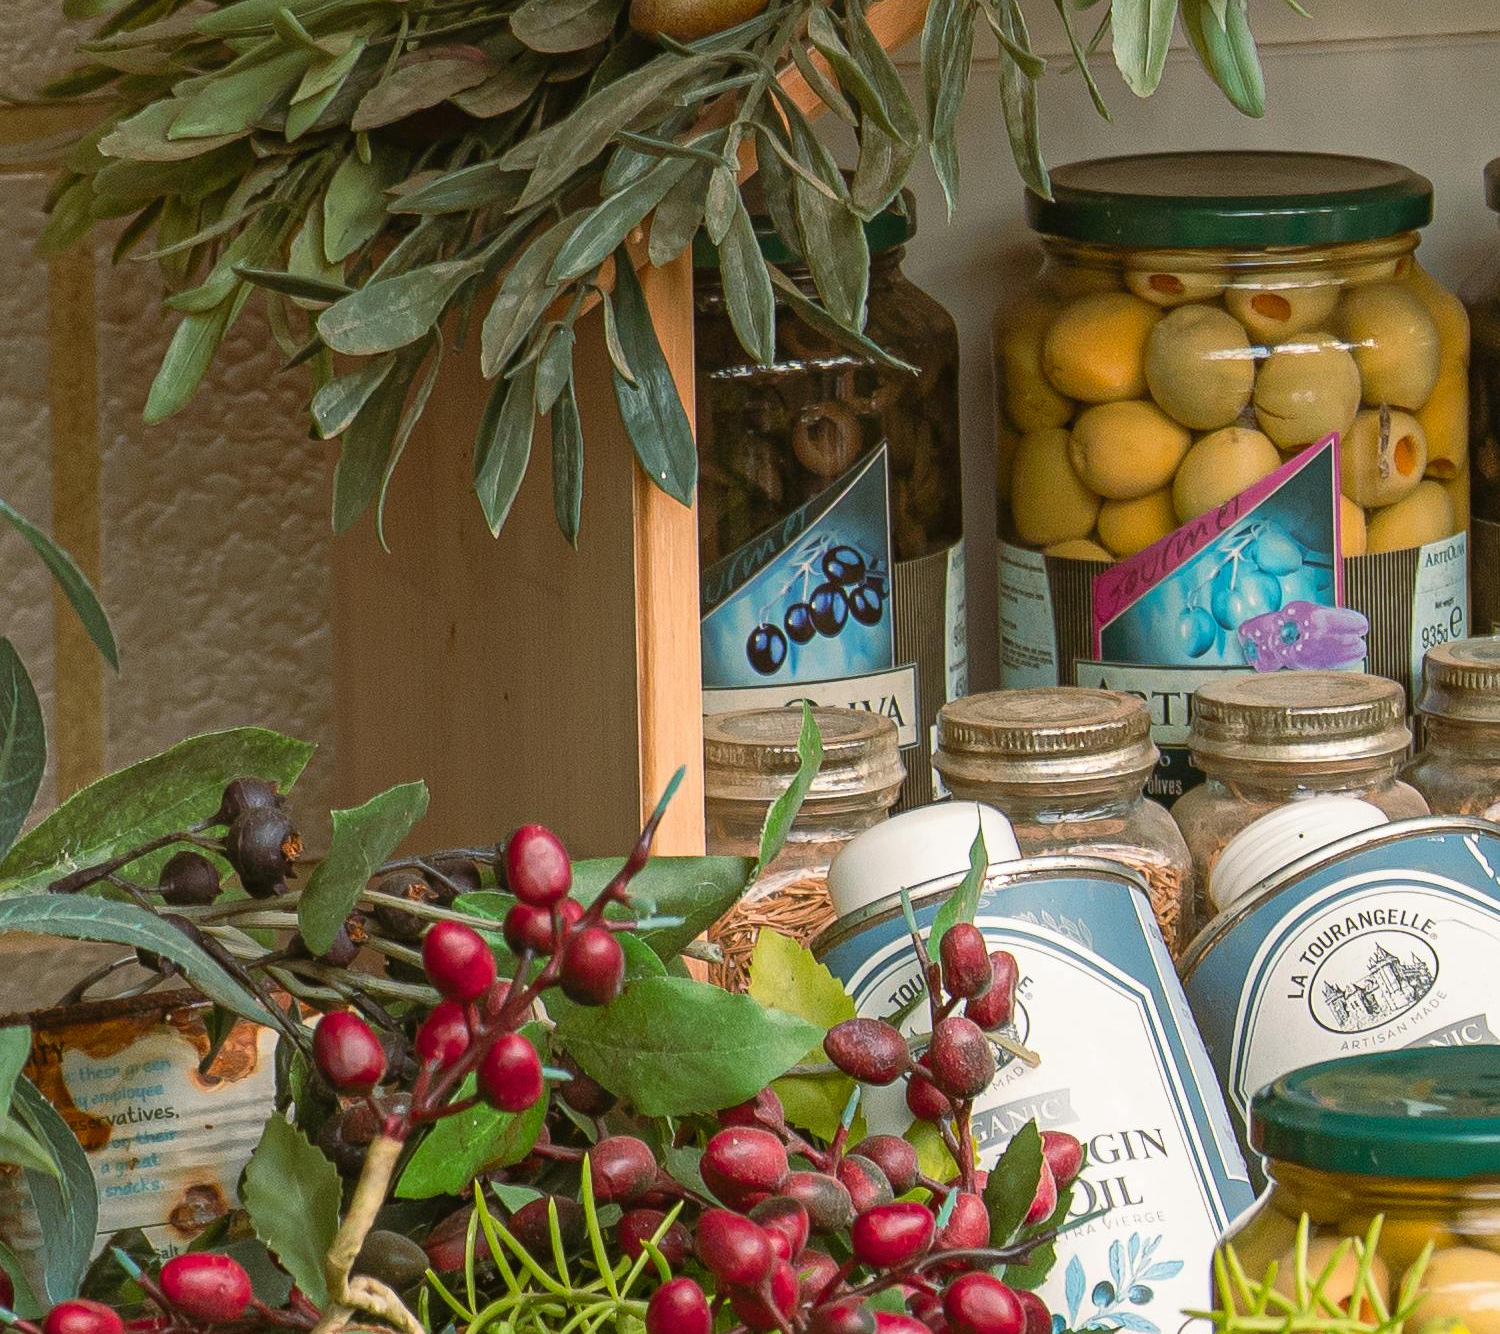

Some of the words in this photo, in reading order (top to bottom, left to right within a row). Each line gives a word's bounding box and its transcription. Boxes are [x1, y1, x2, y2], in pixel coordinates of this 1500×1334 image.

[1287, 974, 1309, 1000] LA
[1300, 908, 1437, 966] TOURANGELLE
[1340, 1022, 1408, 1051] ARTISAN
[1411, 989, 1448, 1026] MADE
[992, 1066, 1024, 1092] MAD
[70, 1105, 181, 1134] eservatives.
[971, 1098, 1062, 1143] GANIC
[1085, 1128, 1169, 1168] GIN
[1064, 1225, 1097, 1242] TRA
